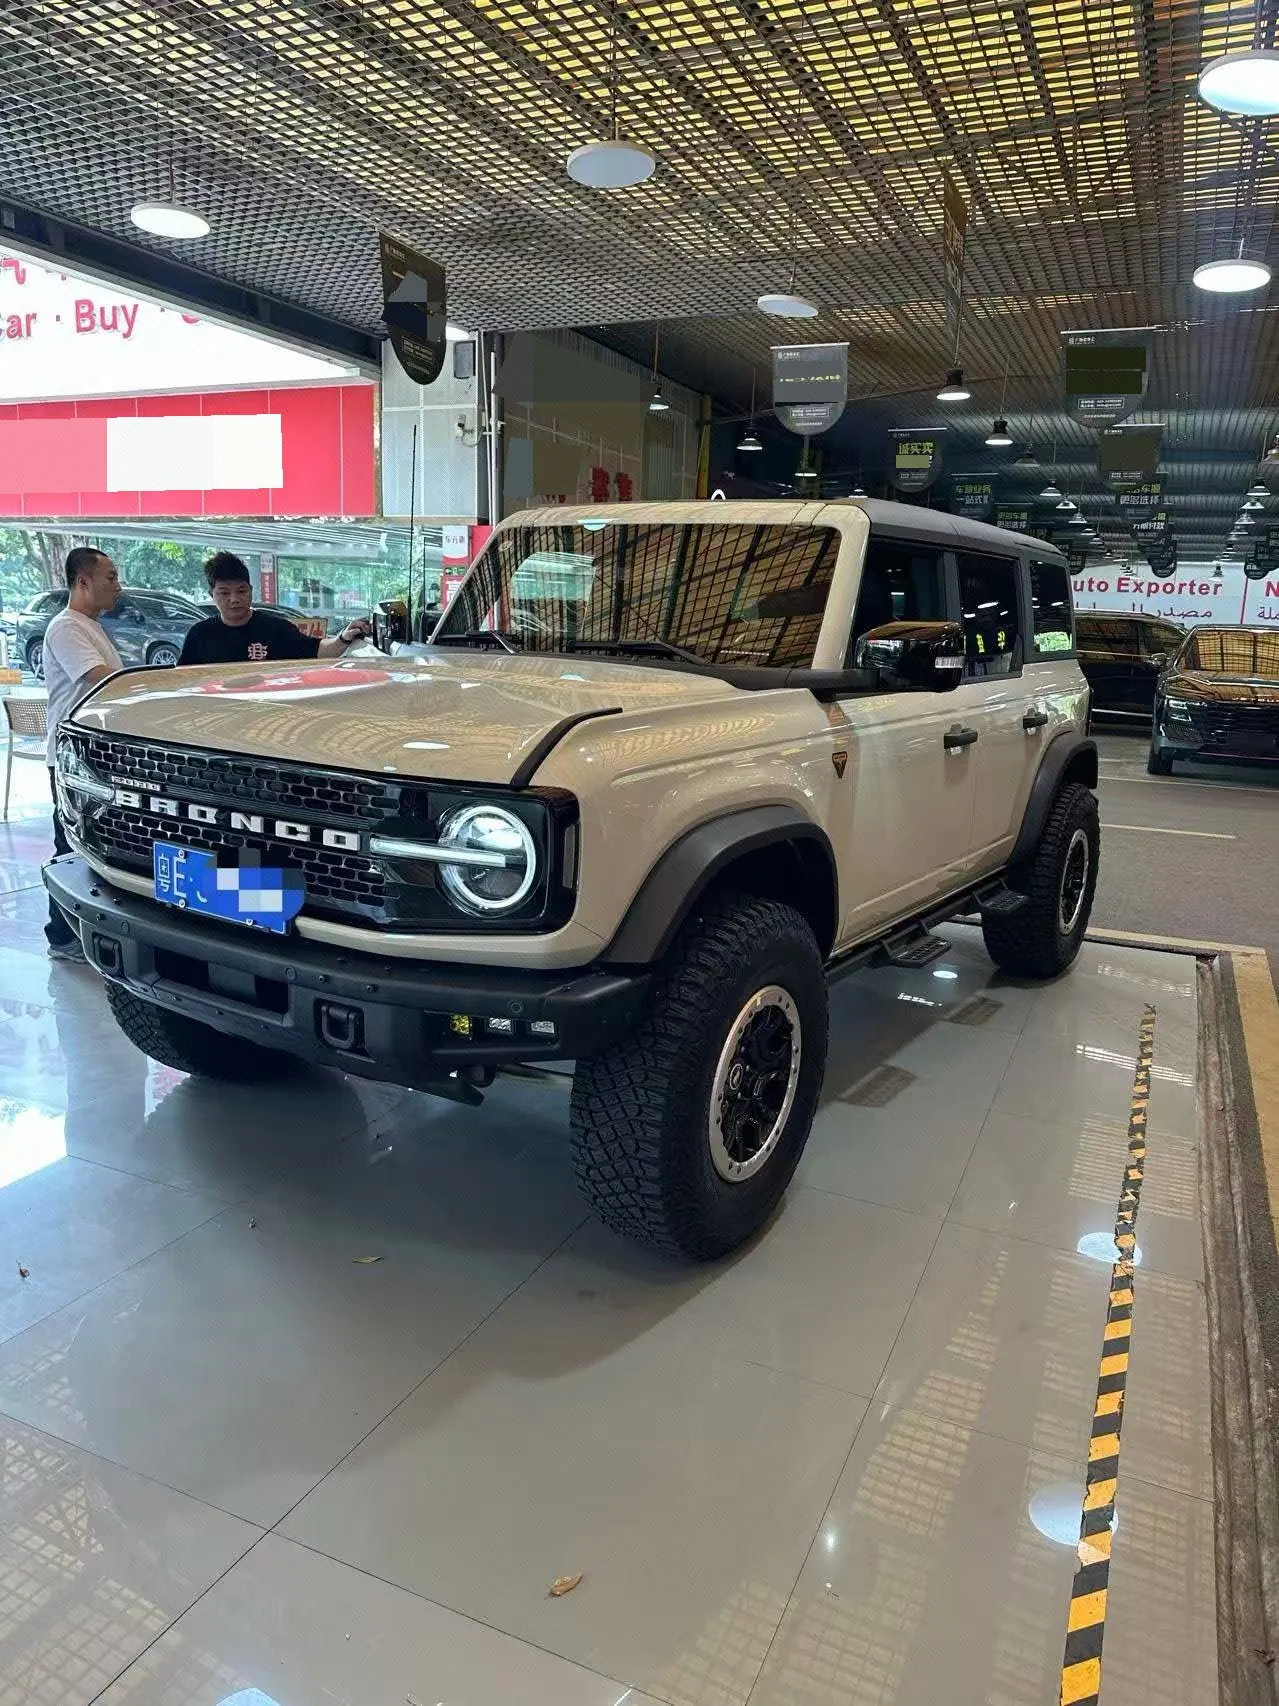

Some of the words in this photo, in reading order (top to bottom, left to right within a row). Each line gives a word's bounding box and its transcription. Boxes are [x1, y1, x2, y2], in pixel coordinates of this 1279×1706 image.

[0, 313, 37, 339] ar
[75, 299, 139, 339] Buy
[1073, 577, 1109, 593] uto
[1117, 577, 1223, 598] Exporter
[115, 789, 361, 851] BRONCO
